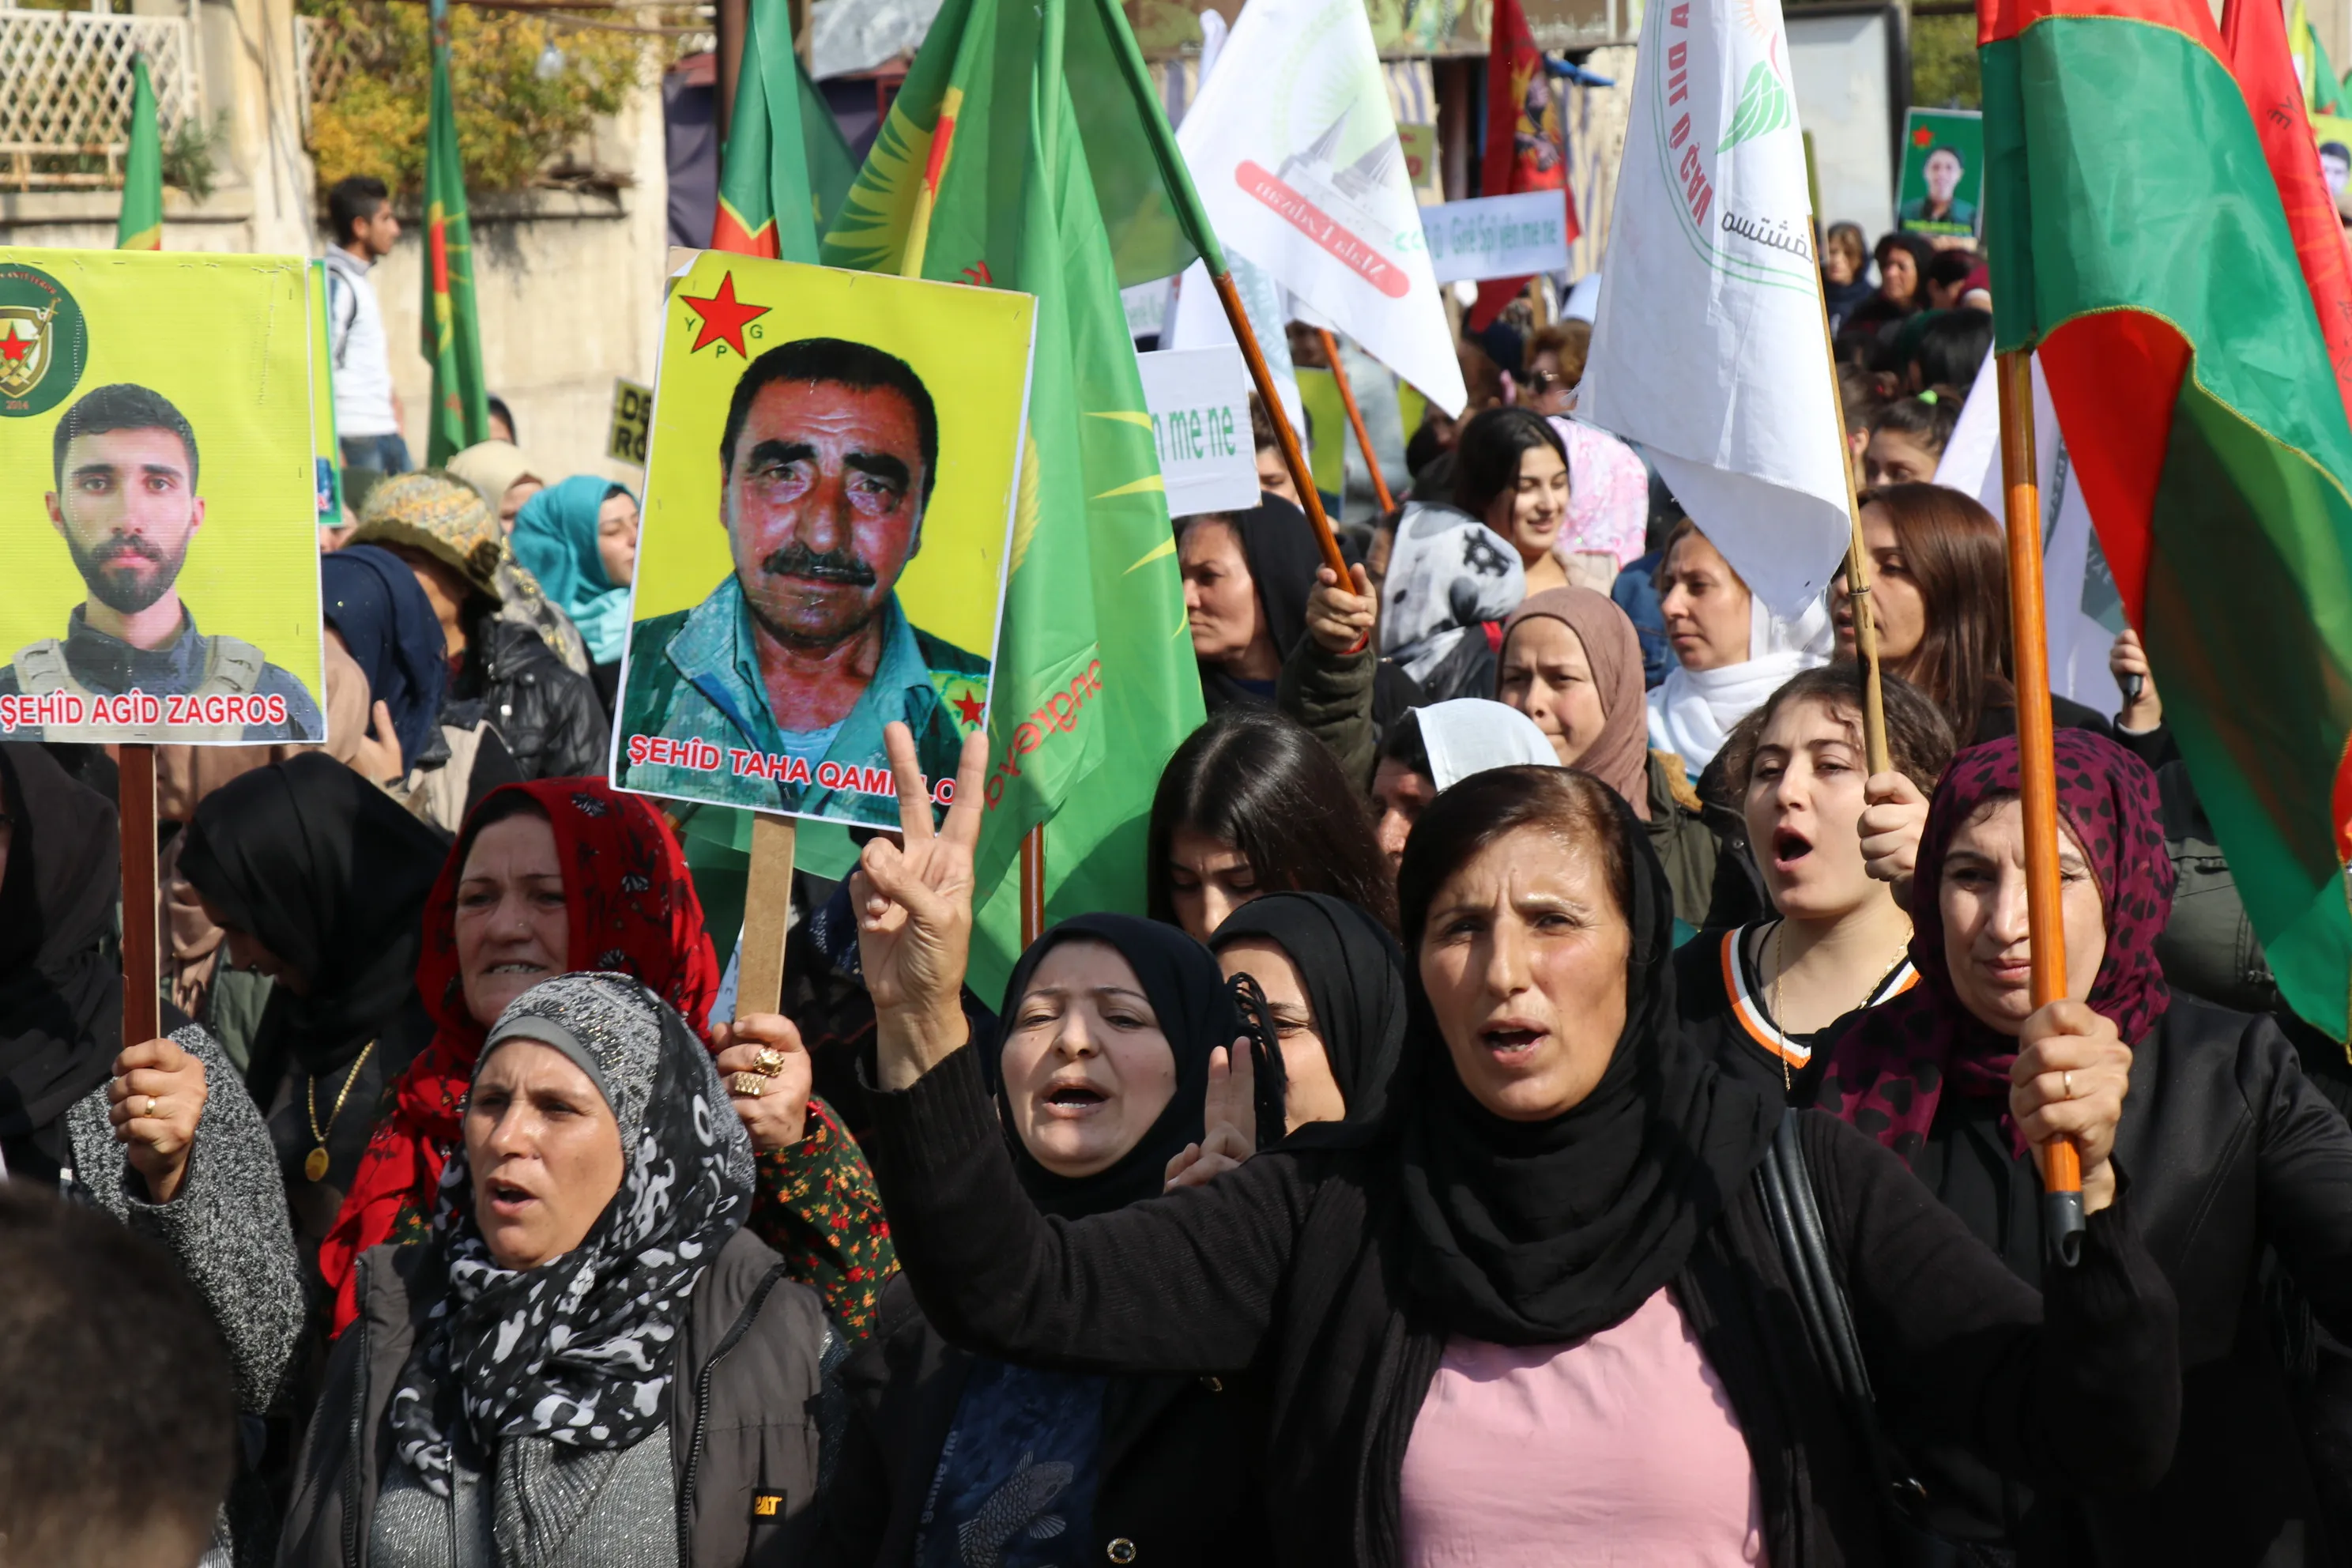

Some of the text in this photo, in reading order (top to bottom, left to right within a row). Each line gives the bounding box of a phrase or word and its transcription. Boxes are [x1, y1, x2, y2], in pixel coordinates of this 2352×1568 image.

[6, 400, 29, 410] 2014
[1169, 409, 1204, 461] me
[1208, 405, 1236, 458] ne
[1, 689, 285, 730] ŞEHÎD AGÎD ZAGROS
[628, 736, 720, 771] ŞEHÎD
[730, 750, 811, 784] TAHA
